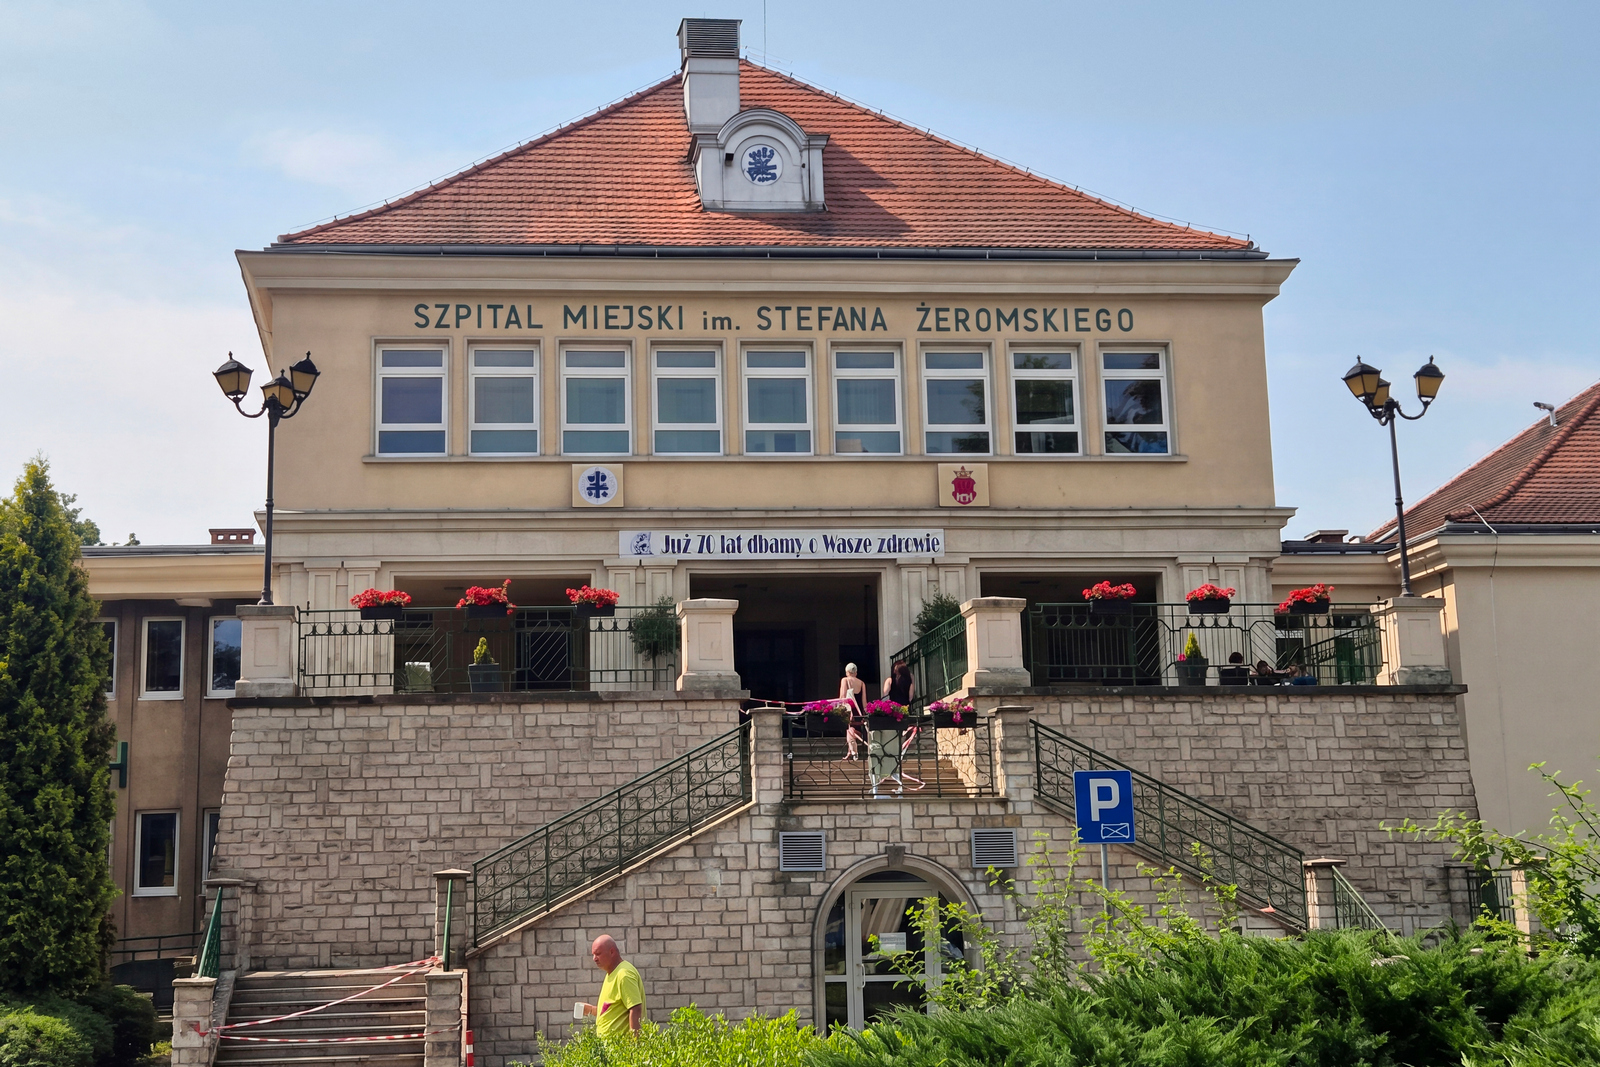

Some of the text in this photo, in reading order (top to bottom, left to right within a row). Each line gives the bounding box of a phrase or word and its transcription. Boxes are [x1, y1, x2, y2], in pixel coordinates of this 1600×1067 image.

[414, 301, 1134, 332] SZPITAL MIEJSKI im. STEFANA ŻEROMSKIEGO
[661, 532, 940, 558] Już 70 lat dbamy o Wasze zdrowie
[1089, 778, 1120, 821] P
